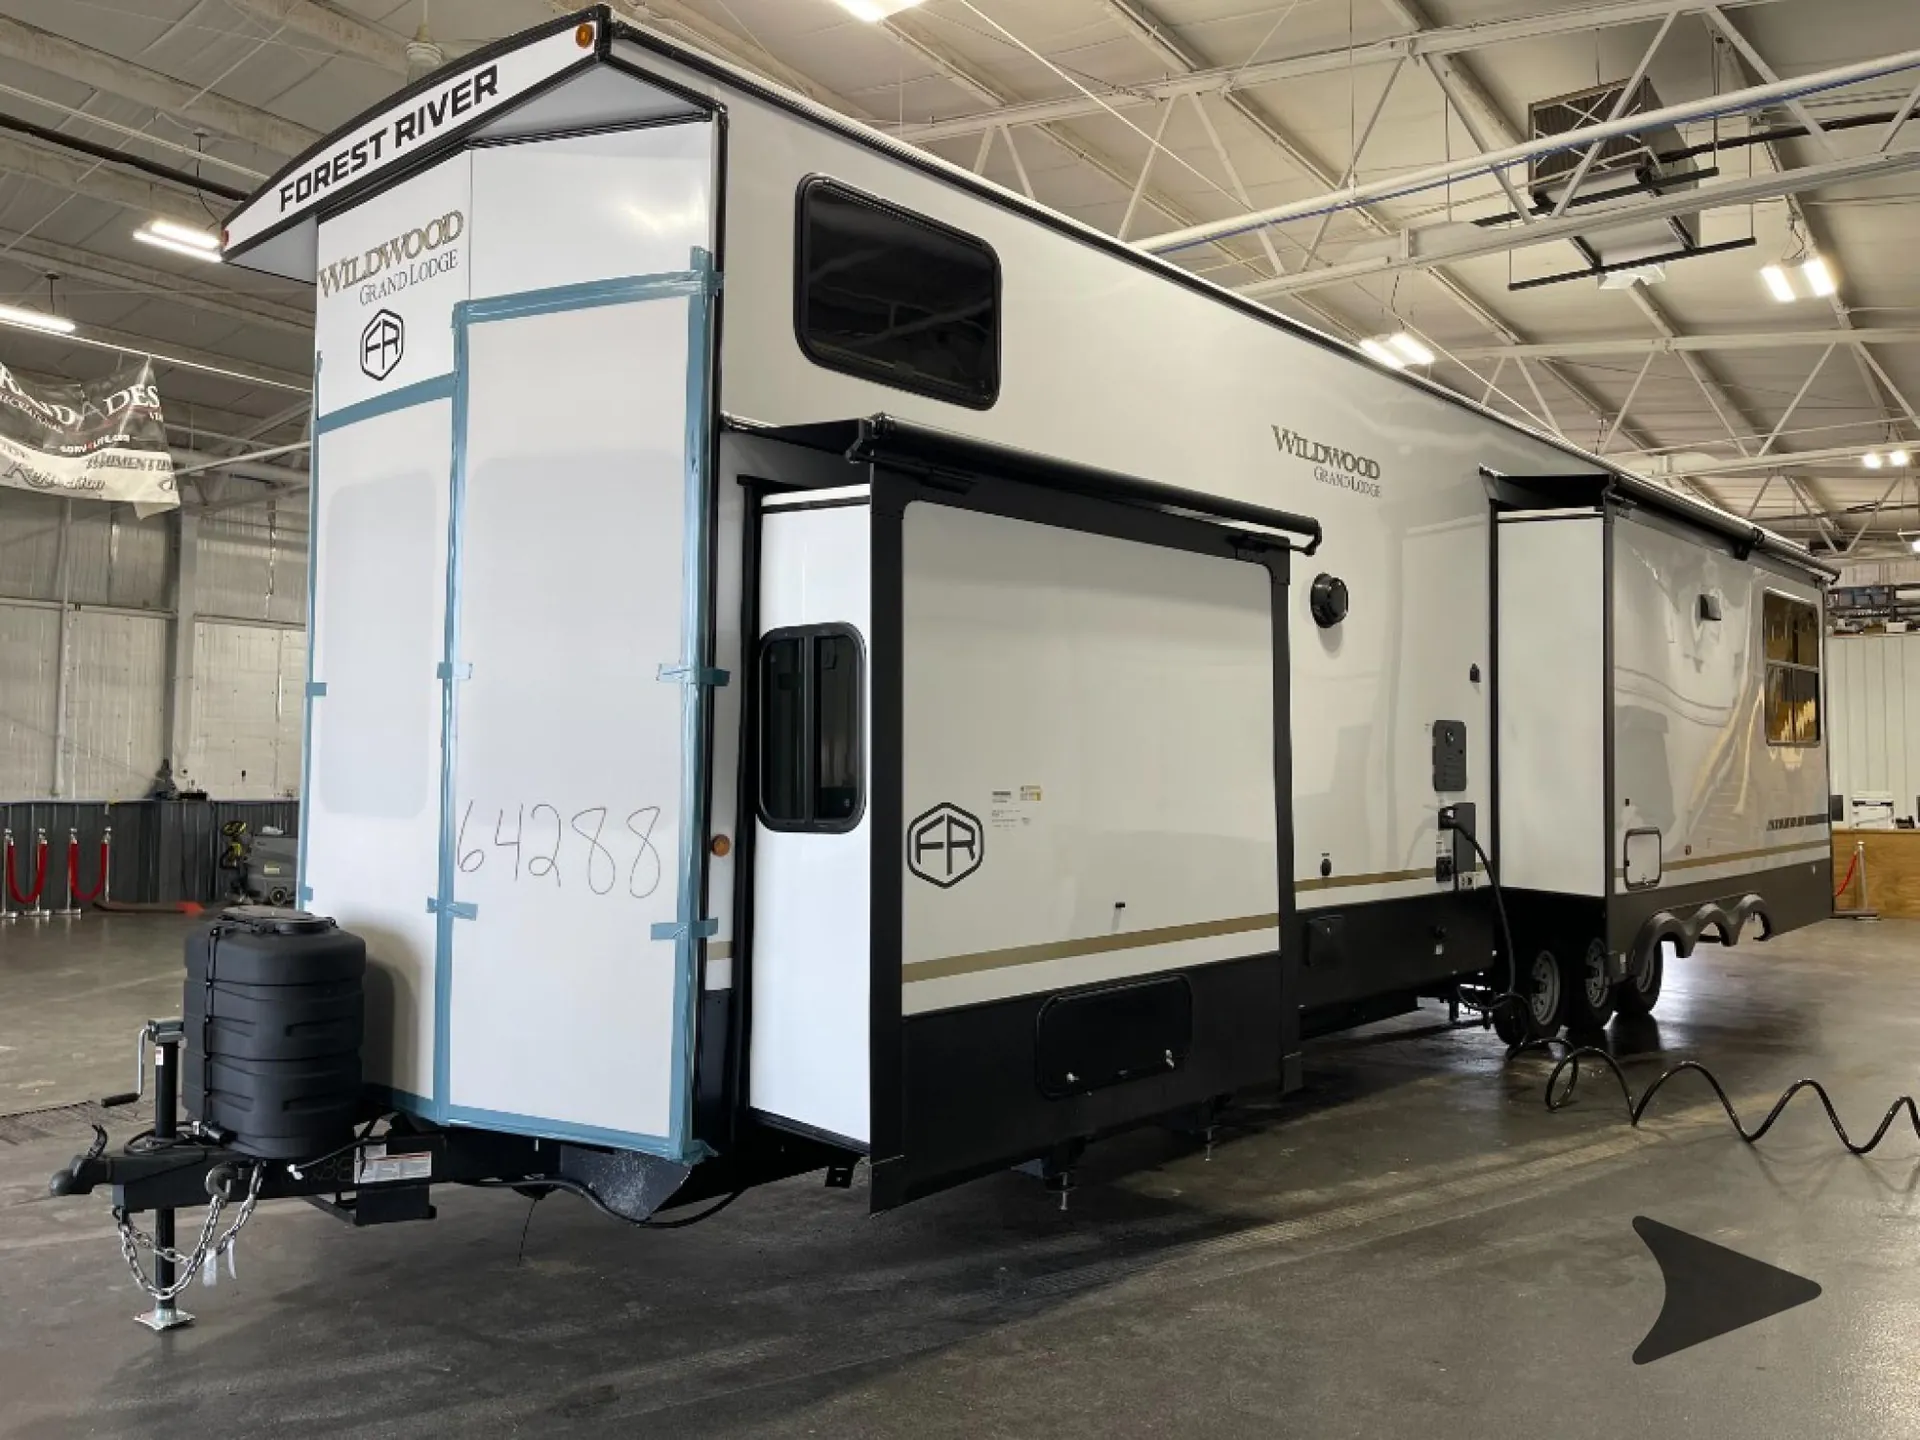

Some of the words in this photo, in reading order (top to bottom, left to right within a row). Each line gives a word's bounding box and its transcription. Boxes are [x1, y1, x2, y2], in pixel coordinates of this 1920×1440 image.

[279, 126, 389, 213] FOREST
[394, 64, 499, 148] RIVER
[317, 210, 464, 298] WILDWOOD
[359, 271, 408, 306] GRAND
[409, 249, 459, 286] LODGE
[1270, 424, 1381, 480] WILDWOOD
[1313, 465, 1351, 489] GRAND
[1351, 475, 1382, 498] LODGE
[457, 800, 661, 899] 64288
